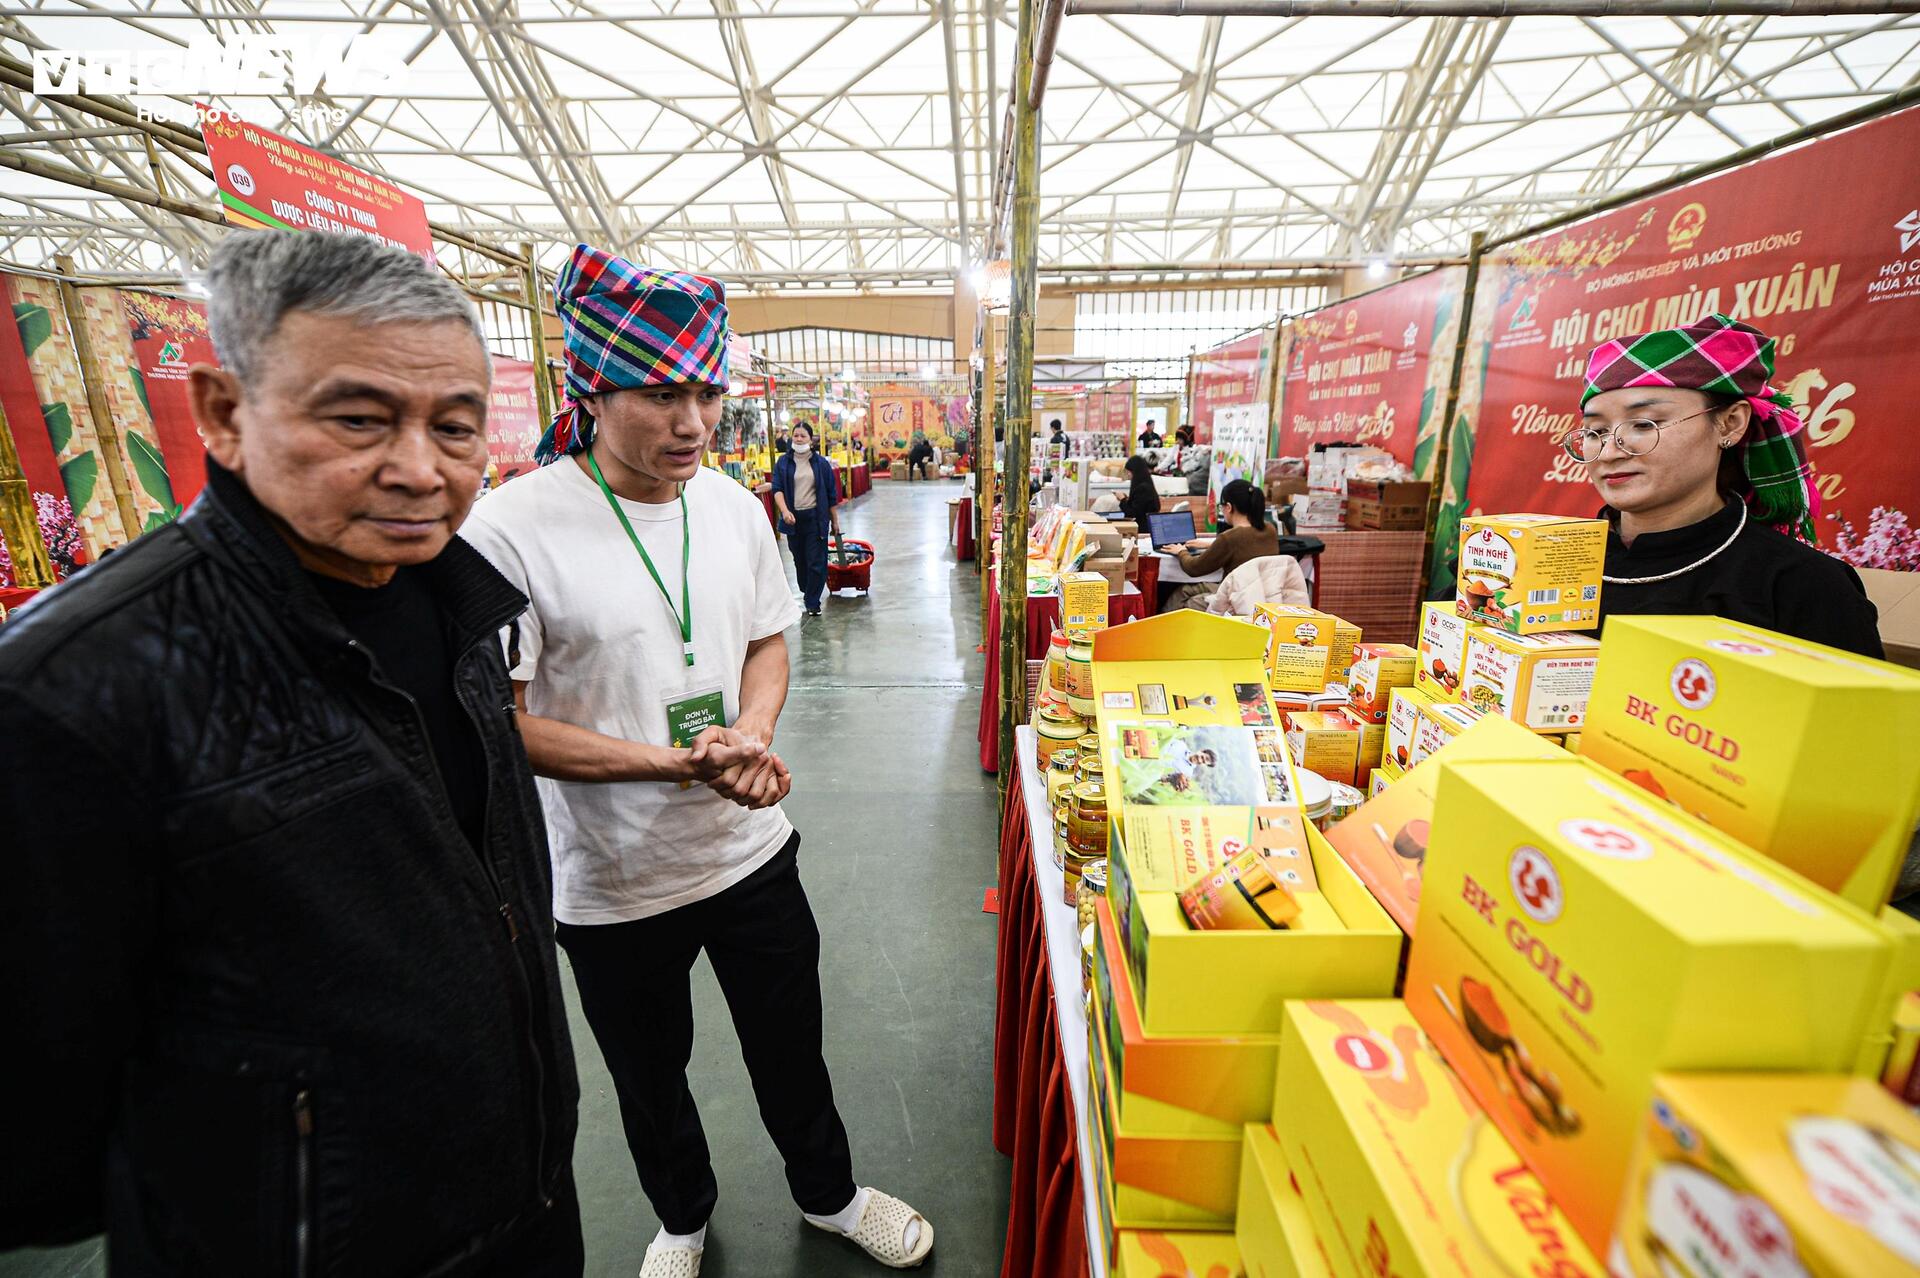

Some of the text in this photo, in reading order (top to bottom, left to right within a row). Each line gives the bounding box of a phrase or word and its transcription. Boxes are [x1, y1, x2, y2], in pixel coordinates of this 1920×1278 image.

[243, 128, 261, 147] HỘI
[261, 136, 281, 155] CHỢ
[231, 172, 250, 187] 039
[271, 198, 305, 226] DƯỢC
[305, 210, 330, 232] LIỆU
[304, 189, 377, 230] CÔNG TY TNHH
[1682, 255, 1700, 272] VÀ
[1701, 245, 1732, 268] MÔI
[1879, 260, 1907, 277] HỘI
[1867, 277, 1901, 294] MÙA
[1550, 305, 1591, 354] HỘI
[1729, 262, 1842, 322] XUÂN
[1307, 360, 1322, 386] HỘI
[1322, 358, 1341, 384] CHỢ
[1340, 352, 1362, 378] MÙA
[1362, 346, 1393, 375] XUÂN
[1511, 404, 1577, 445] Nông
[1468, 545, 1508, 563] TINH NGHỆ
[1473, 558, 1502, 572] Bắc Kạn
[679, 718, 703, 730] TRƯNG
[685, 708, 709, 720] ĐƠN VỊ
[1624, 694, 1742, 763] BK GOLD
[1180, 819, 1198, 874] BK GOLD
[1461, 873, 1594, 1014] BK GOLD
